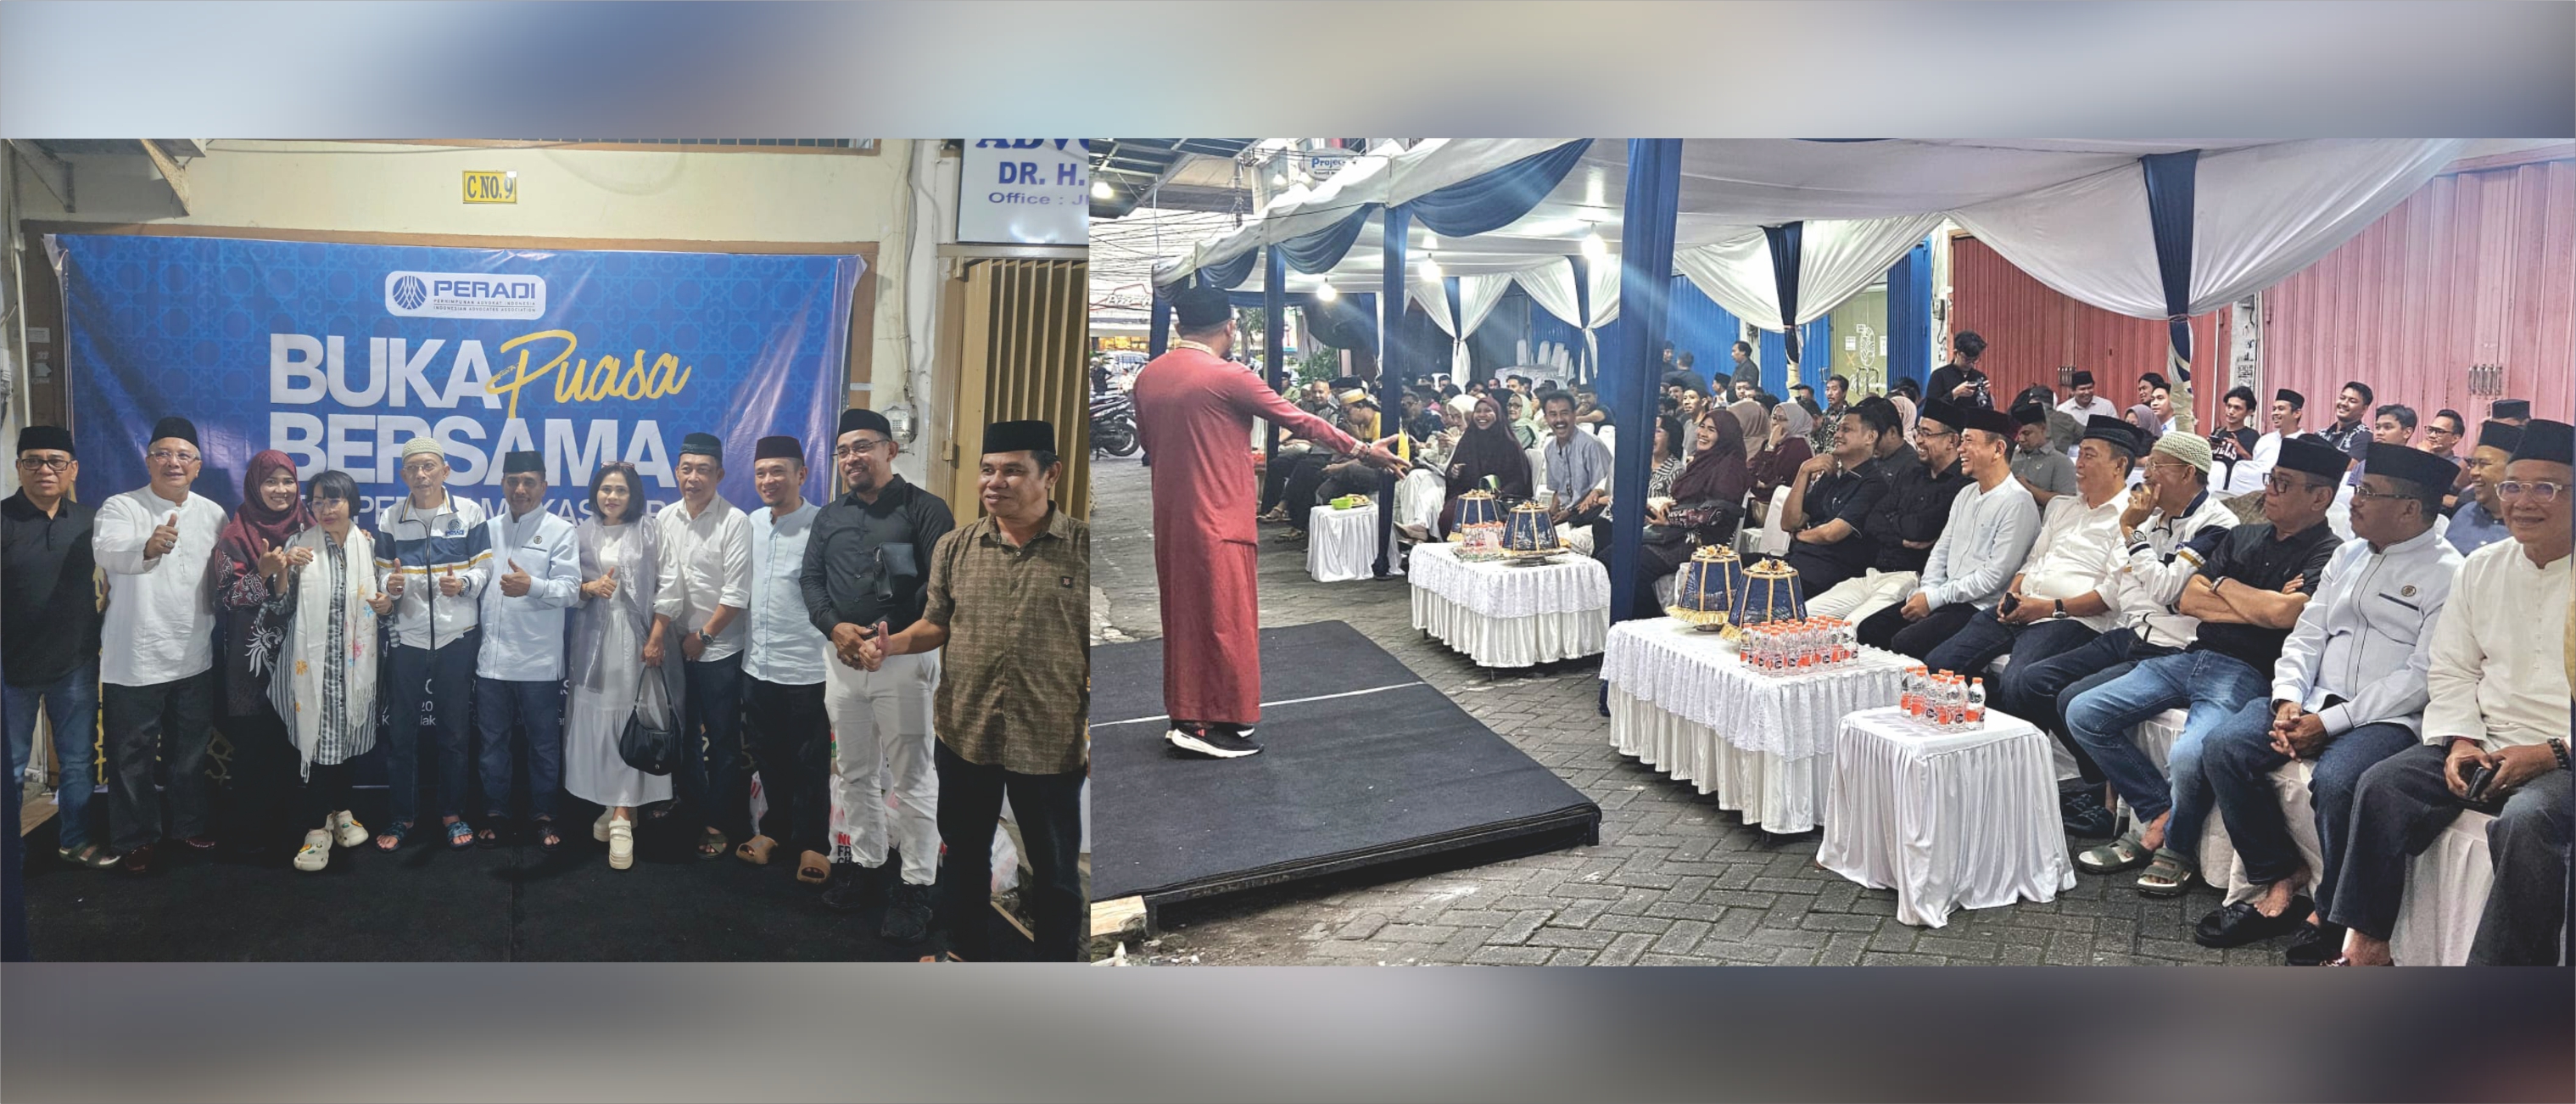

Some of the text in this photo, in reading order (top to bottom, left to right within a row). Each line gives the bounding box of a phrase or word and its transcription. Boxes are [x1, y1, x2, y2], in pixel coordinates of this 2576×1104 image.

[998, 161, 1086, 187] DR. H.
[467, 175, 477, 199] C
[988, 192, 1051, 205] Office
[433, 280, 536, 299] PERADI
[270, 329, 692, 419] BUKA Puasa
[270, 412, 677, 488] BERSAMA
